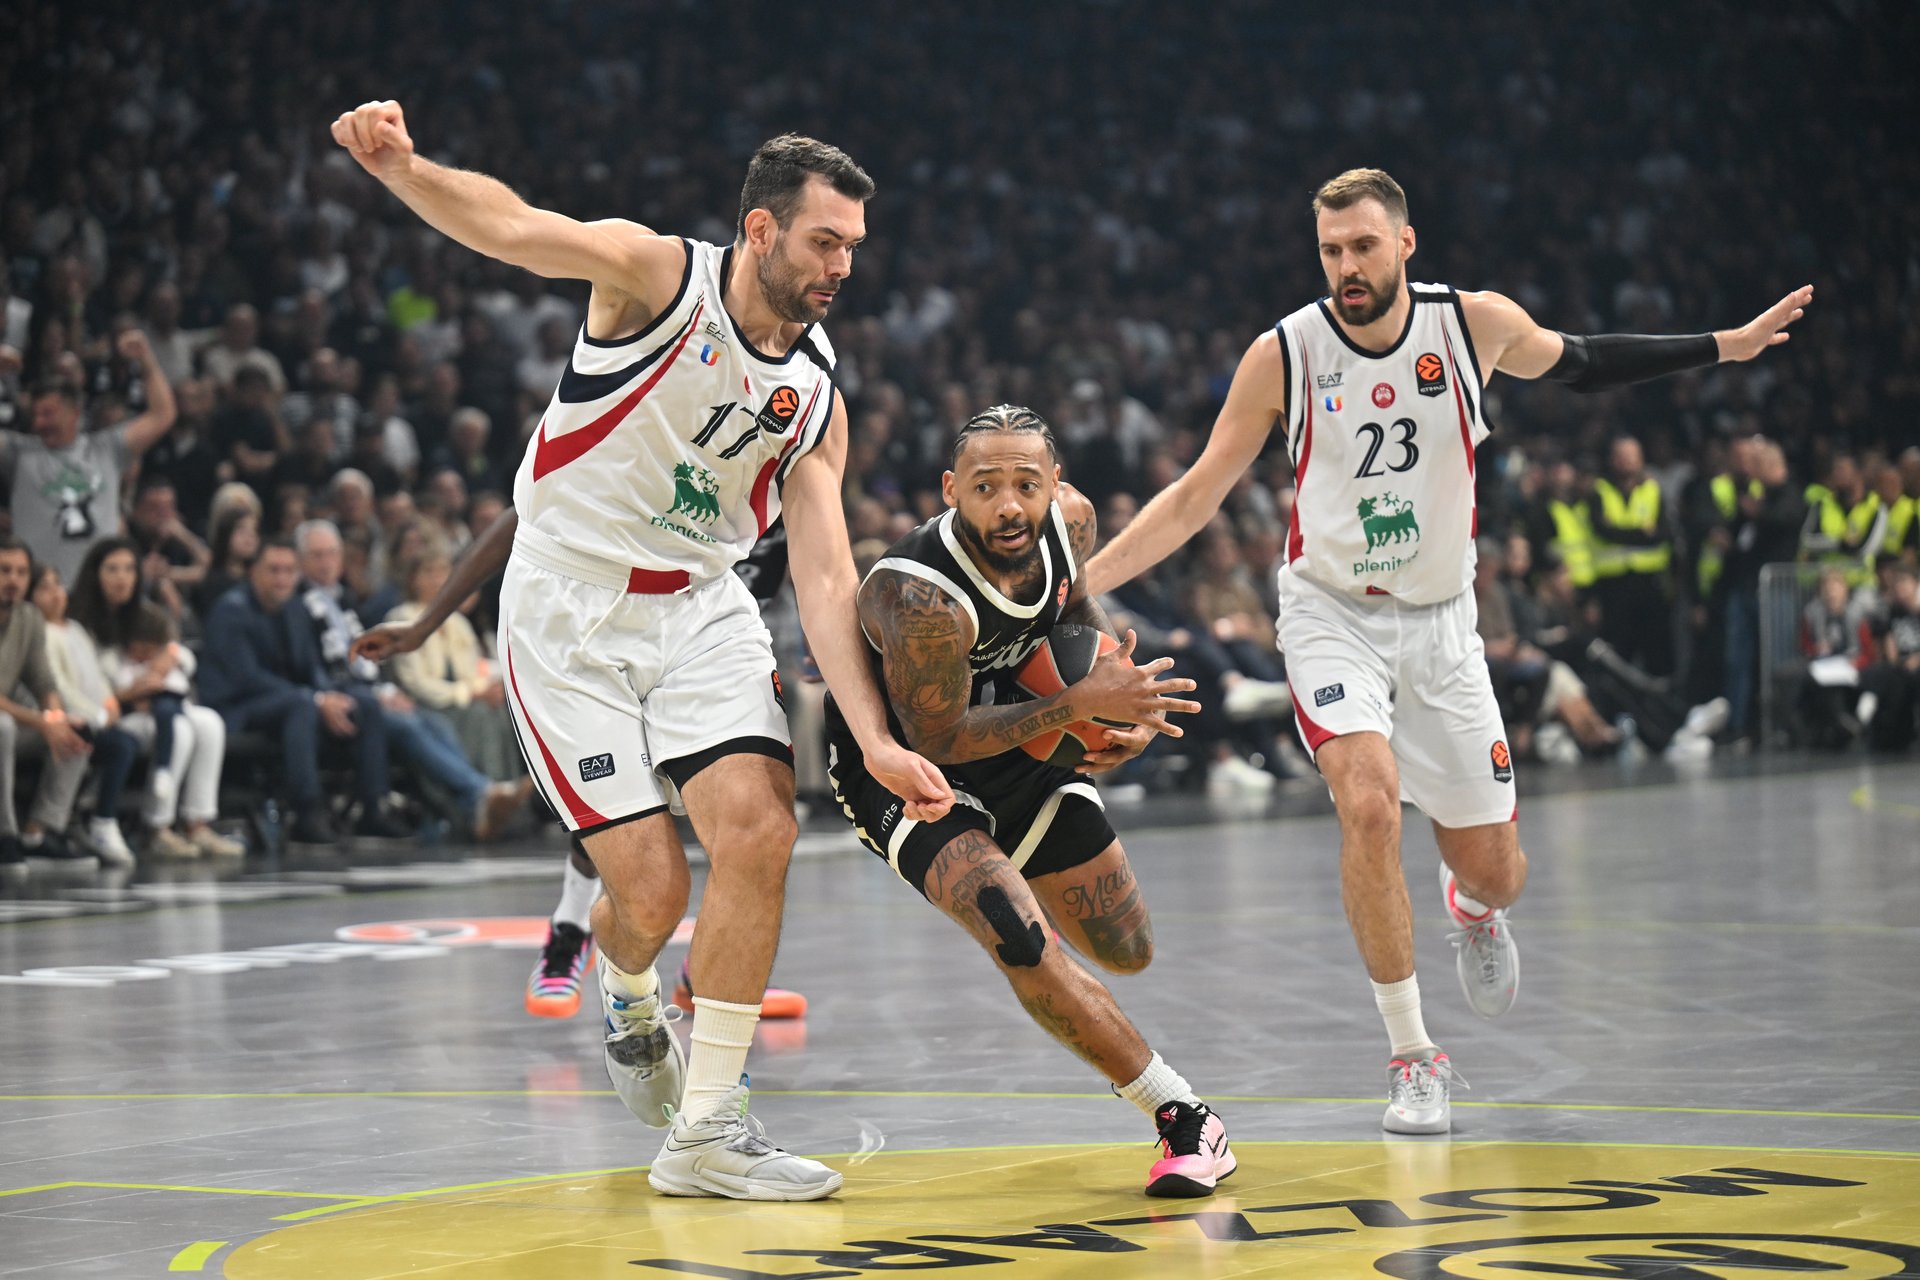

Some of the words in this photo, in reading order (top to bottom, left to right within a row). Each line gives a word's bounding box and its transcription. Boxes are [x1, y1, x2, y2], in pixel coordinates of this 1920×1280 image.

[1317, 372, 1343, 386] EA7
[1420, 384, 1446, 393] ETIHAD
[690, 401, 761, 460] 17
[760, 414, 784, 432] ETIHAD
[1353, 417, 1420, 479] 23
[1353, 549, 1419, 576] plenit
[1315, 685, 1340, 700] EA7
[581, 755, 610, 772] EA7
[583, 768, 613, 780] EYEWEAR
[881, 803, 898, 832] mts
[628, 1167, 1868, 1280] MOZZART
